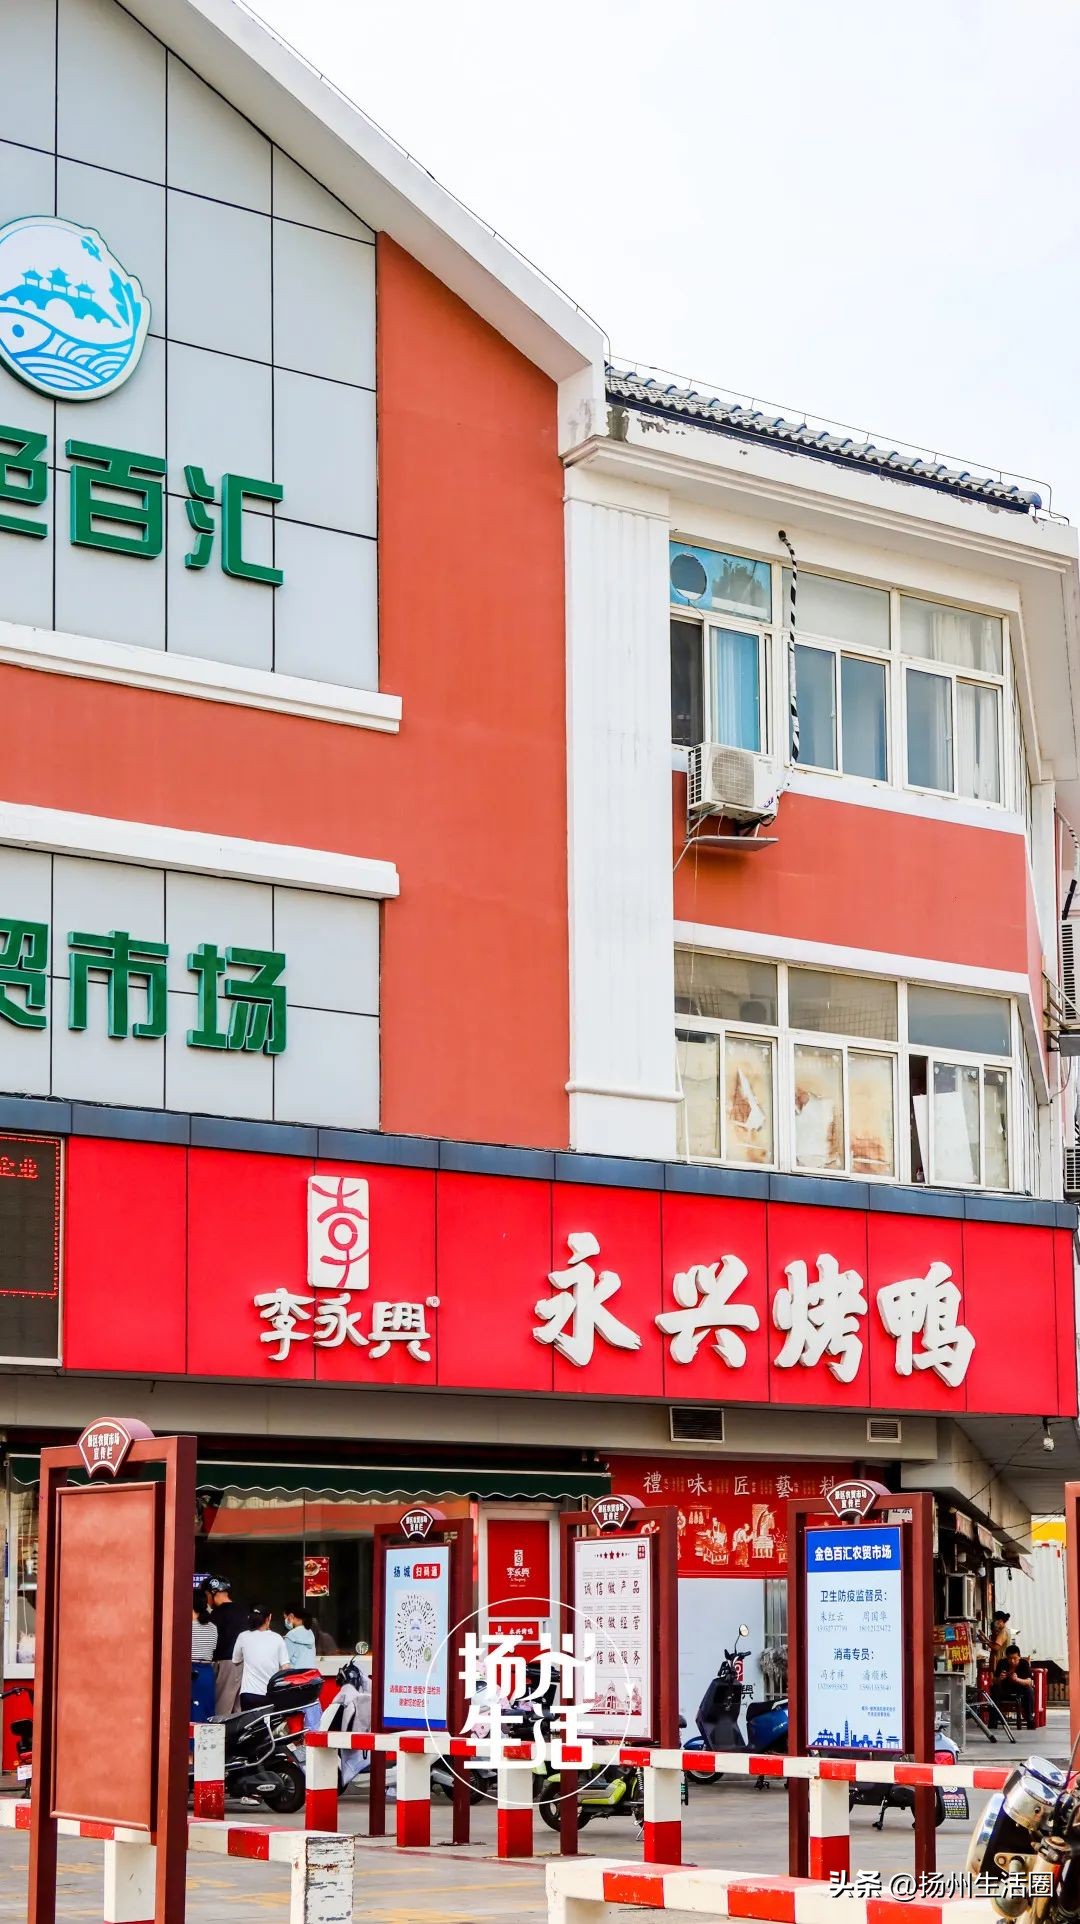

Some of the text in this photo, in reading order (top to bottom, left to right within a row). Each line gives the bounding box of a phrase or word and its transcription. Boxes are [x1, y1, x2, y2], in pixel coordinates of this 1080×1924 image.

[532, 1231, 976, 1388] 永兴烤鸭
[253, 1287, 431, 1362] 李永興
[814, 1544, 892, 1561] 金色百汇农贸市场
[415, 1566, 438, 1577] 扫码通
[585, 1650, 641, 1666] 信做服务
